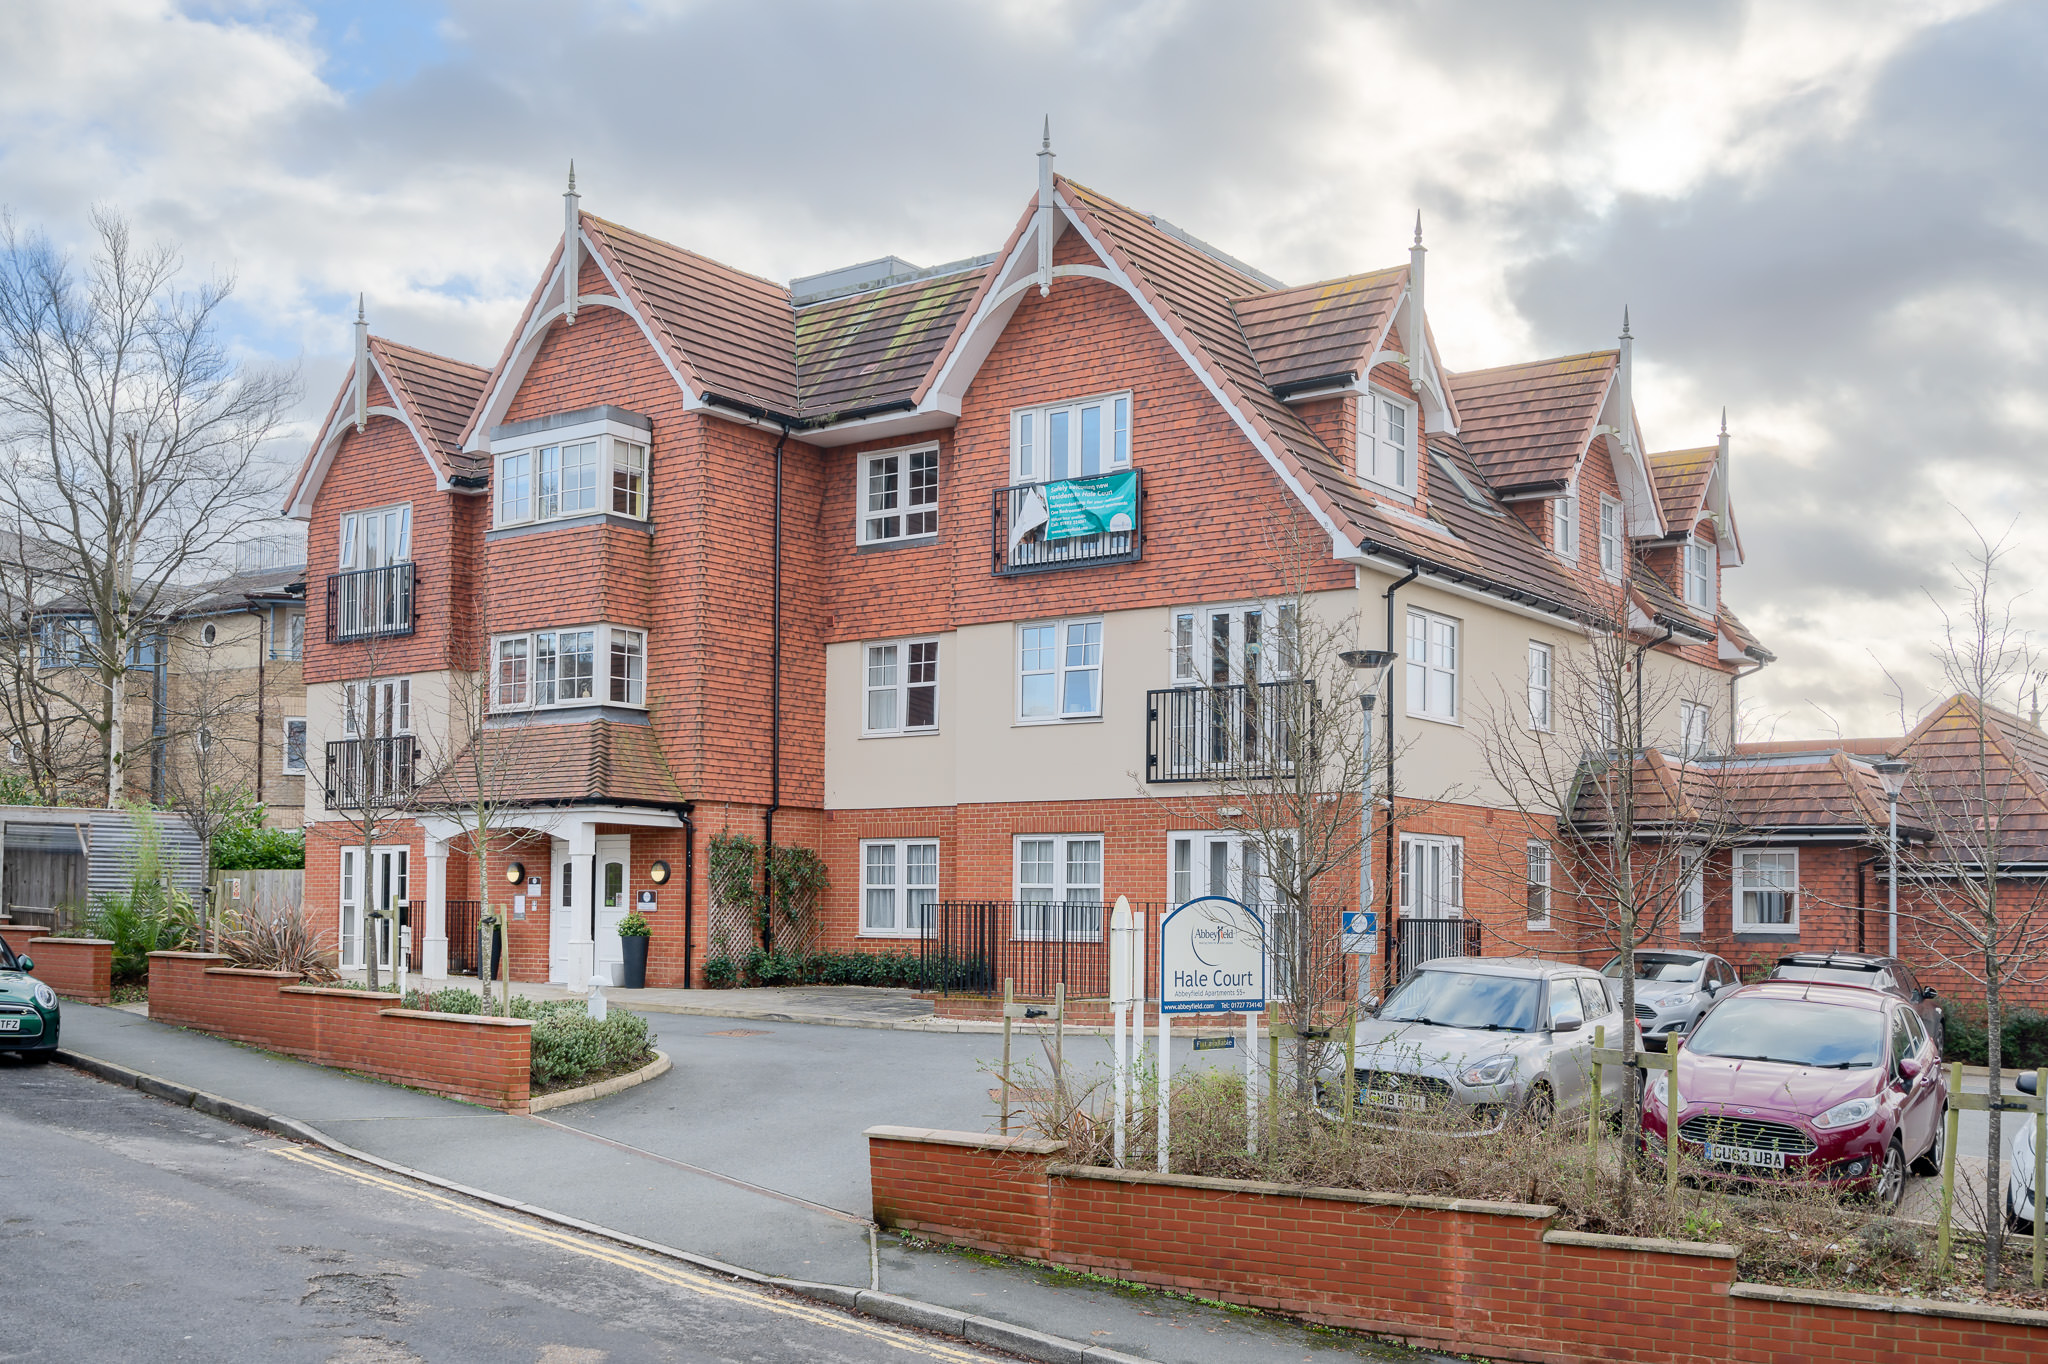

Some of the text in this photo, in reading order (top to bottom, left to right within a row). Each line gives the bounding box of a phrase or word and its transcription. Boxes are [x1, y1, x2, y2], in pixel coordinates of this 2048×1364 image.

[1051, 484, 1067, 492] Safely
[1195, 926, 1233, 944] Abbeyfield
[1174, 969, 1254, 988] Hale Court
[1175, 989, 1203, 998] Abbeyfield
[1205, 989, 1235, 997] Apartments
[1164, 1002, 1215, 1011] www.abbeyfield.com
[0, 1020, 18, 1029] TFZ
[1754, 1151, 1782, 1166] UBA
